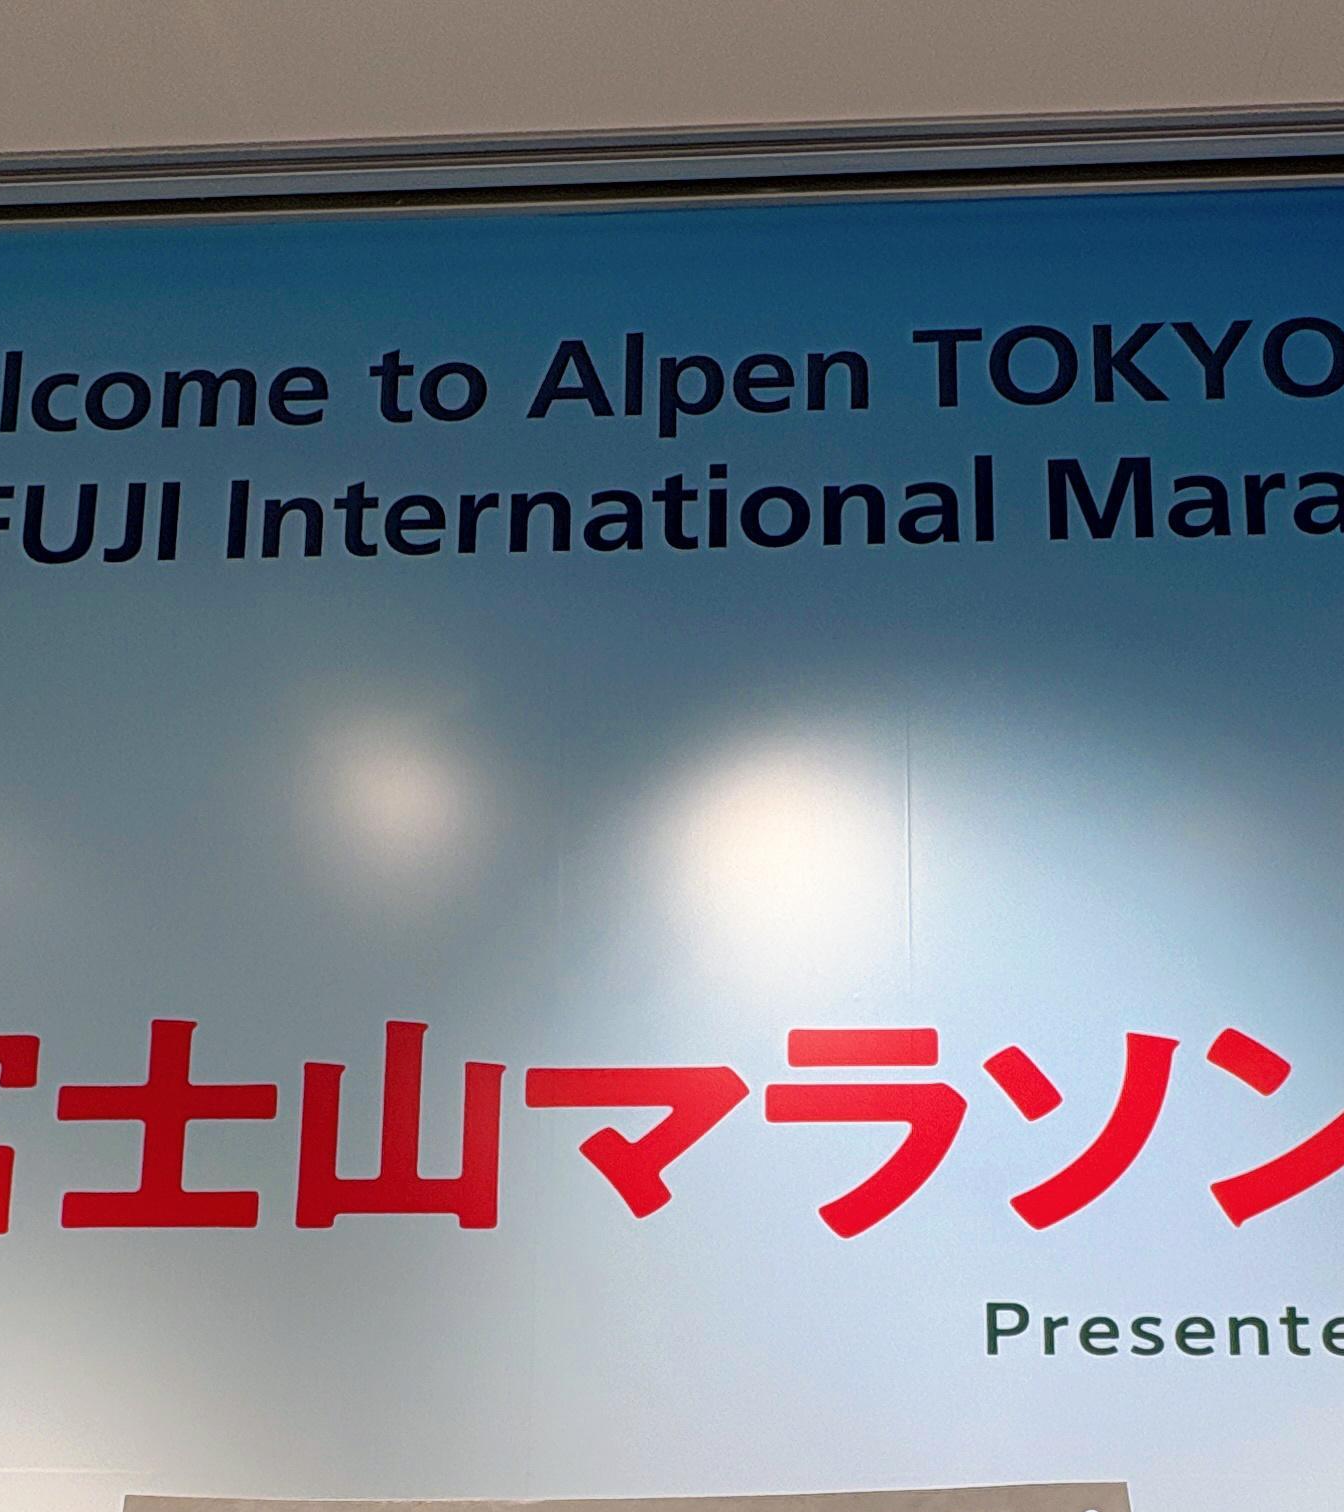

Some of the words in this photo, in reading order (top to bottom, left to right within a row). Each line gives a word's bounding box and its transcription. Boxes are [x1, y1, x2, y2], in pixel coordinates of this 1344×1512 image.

[367, 344, 488, 425] to
[524, 330, 871, 437] Alpen
[224, 454, 996, 561] International
